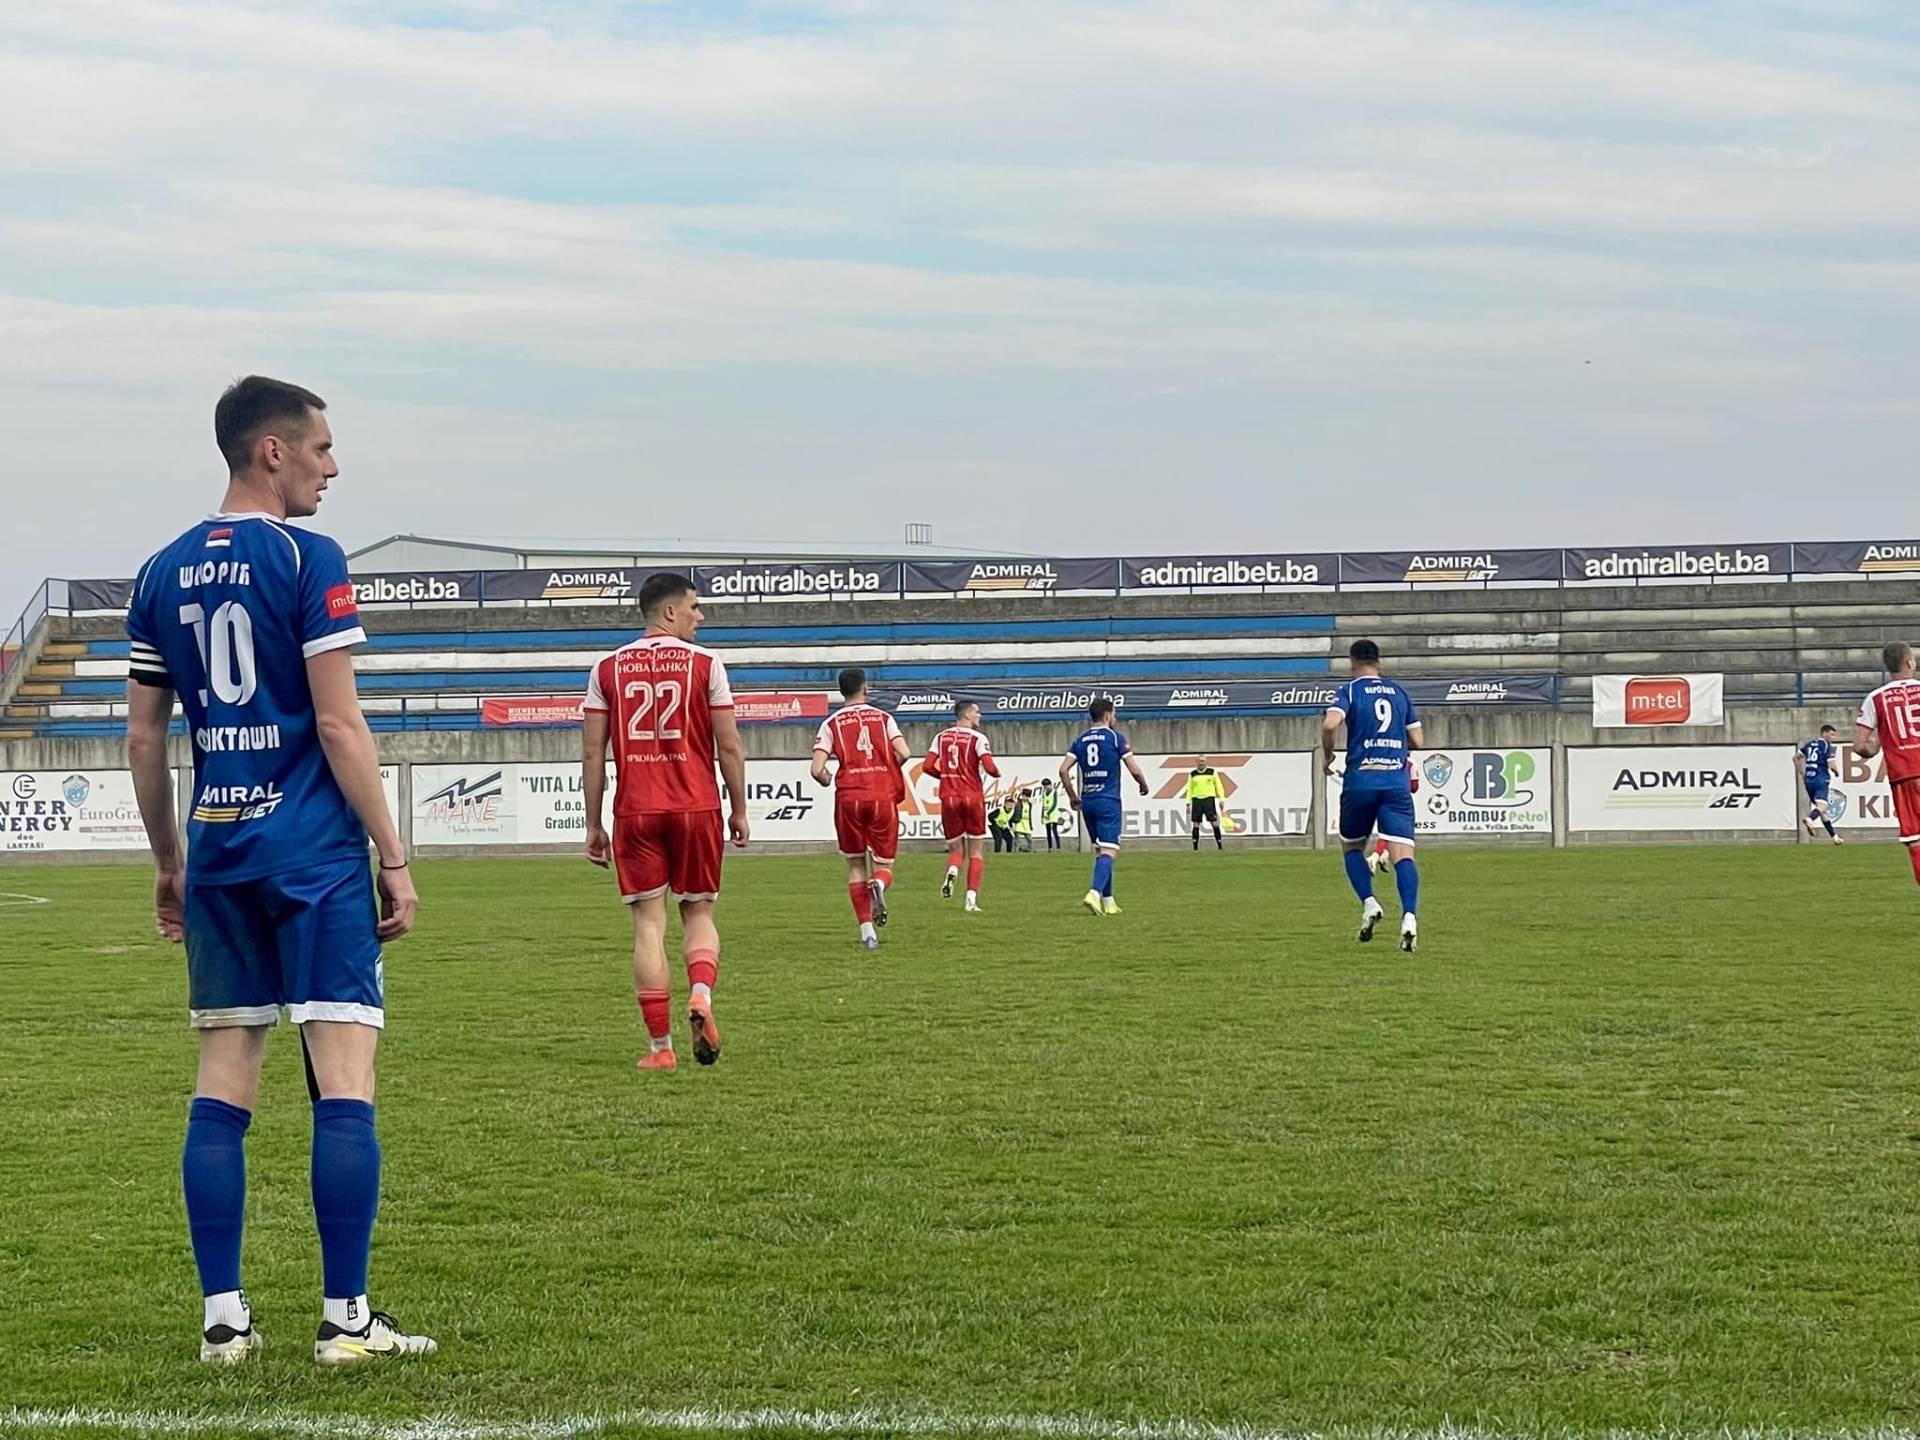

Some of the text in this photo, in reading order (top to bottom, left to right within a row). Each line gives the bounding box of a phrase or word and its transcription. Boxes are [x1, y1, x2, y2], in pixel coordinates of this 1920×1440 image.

[1864, 545, 1917, 560] ADMI
[1408, 554, 1499, 570] ADMIRAL
[1585, 550, 1769, 577] admiralbet.ba
[546, 571, 632, 586] ADMIRAL
[970, 563, 1058, 579] ADMIRAL
[1141, 559, 1318, 585] admiralbet.ba
[1467, 570, 1499, 580] BET
[711, 568, 880, 594] admiralbet.ba
[1026, 578, 1058, 589] BET
[601, 586, 631, 596] BET
[179, 600, 256, 708] 10
[636, 649, 692, 661] СЛБОДА
[1171, 689, 1228, 698] ADMIRAL
[1449, 683, 1508, 693] ADMIRAL
[900, 694, 956, 703] ADMIRAL
[1632, 690, 1683, 709] m:tel
[625, 680, 682, 740] 22
[1375, 698, 1392, 733] 9
[857, 726, 873, 759] 4
[948, 744, 959, 769] 3
[1087, 743, 1099, 767] 8
[521, 775, 563, 792] "VITA
[1473, 751, 1535, 800] BP
[1613, 768, 1761, 790] ADMIRAL
[554, 800, 585, 812] d.o.o.
[1709, 793, 1761, 808] BET
[766, 805, 814, 820] BET
[1448, 810, 1548, 823] BAMBUS Petrol
[1121, 808, 1308, 834] EHNSINT
